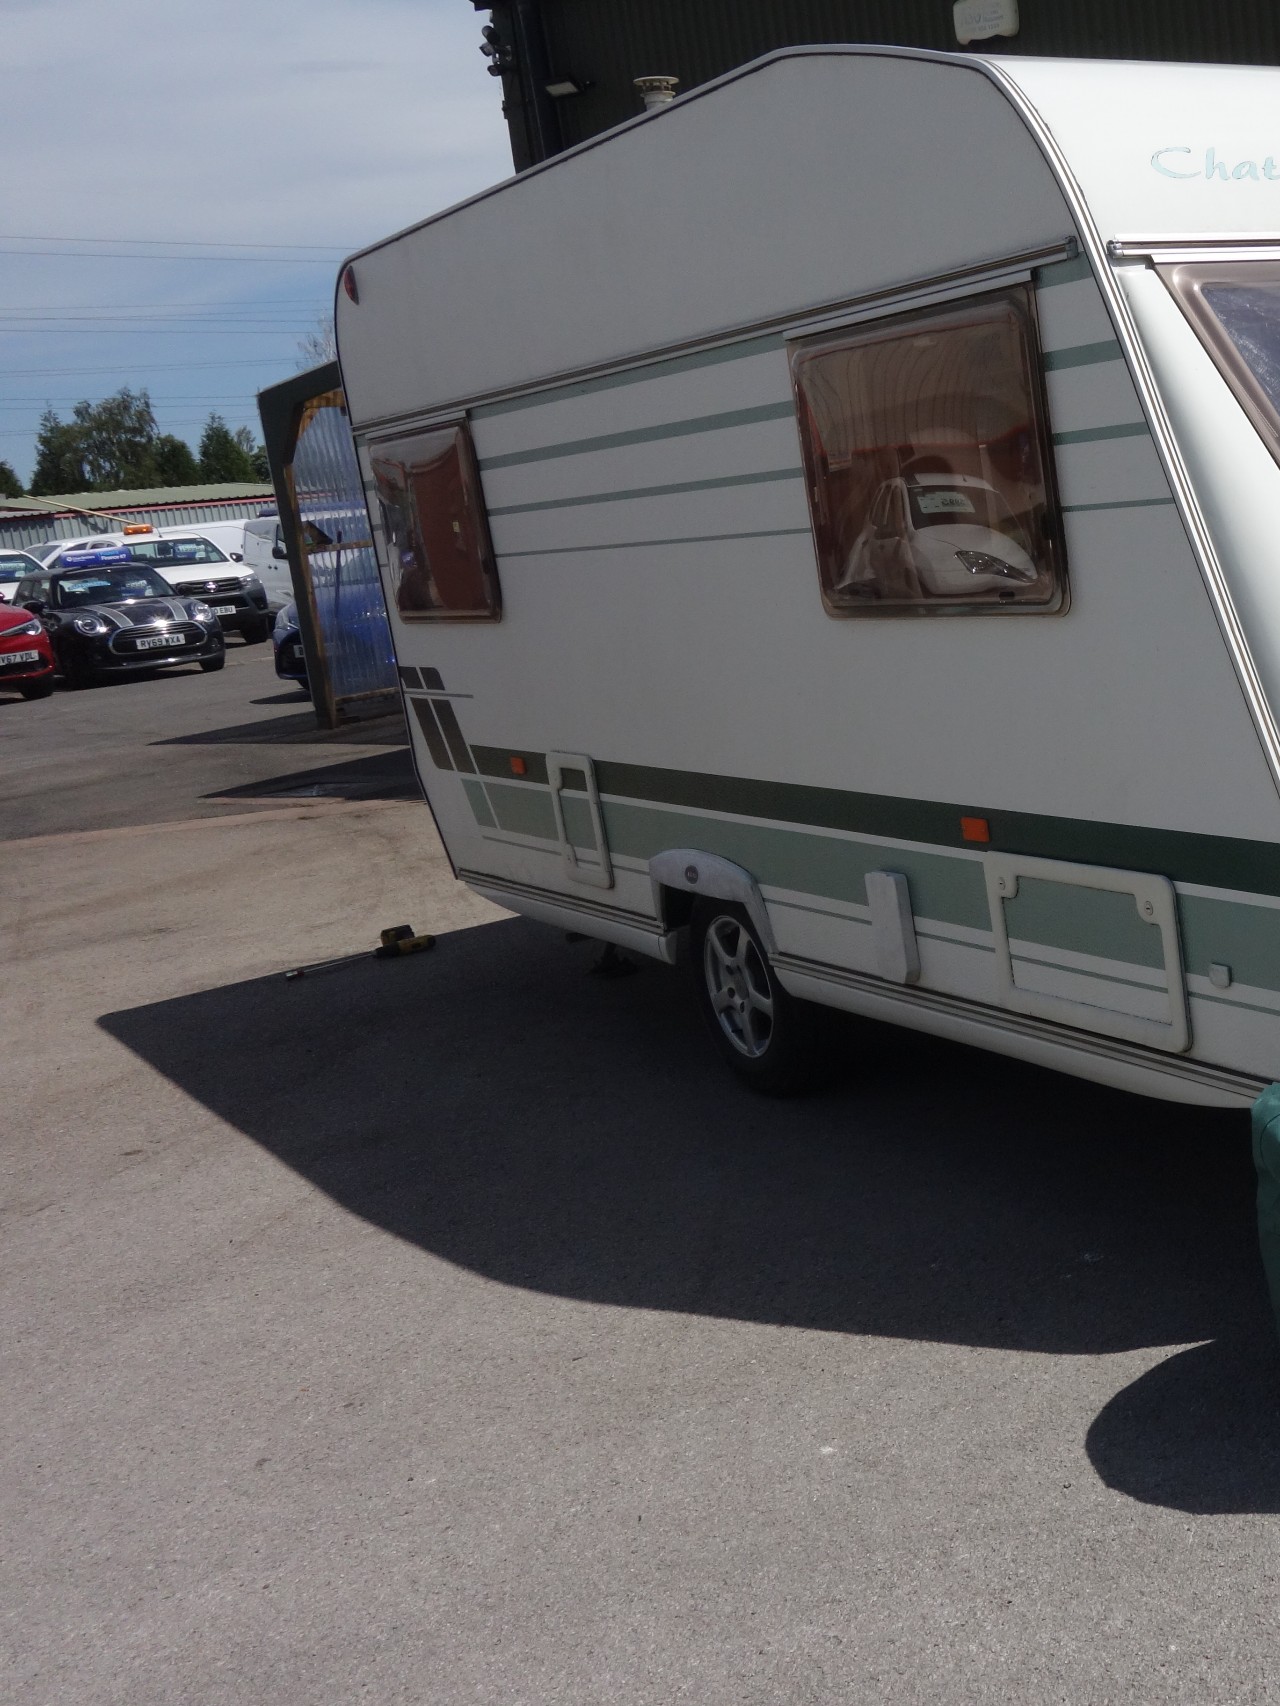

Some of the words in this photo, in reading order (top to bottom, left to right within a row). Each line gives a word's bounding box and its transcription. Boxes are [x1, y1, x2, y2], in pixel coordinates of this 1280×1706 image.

[140, 638, 163, 648] RV69
[166, 636, 181, 646] WXA
[0, 652, 19, 664] V67
